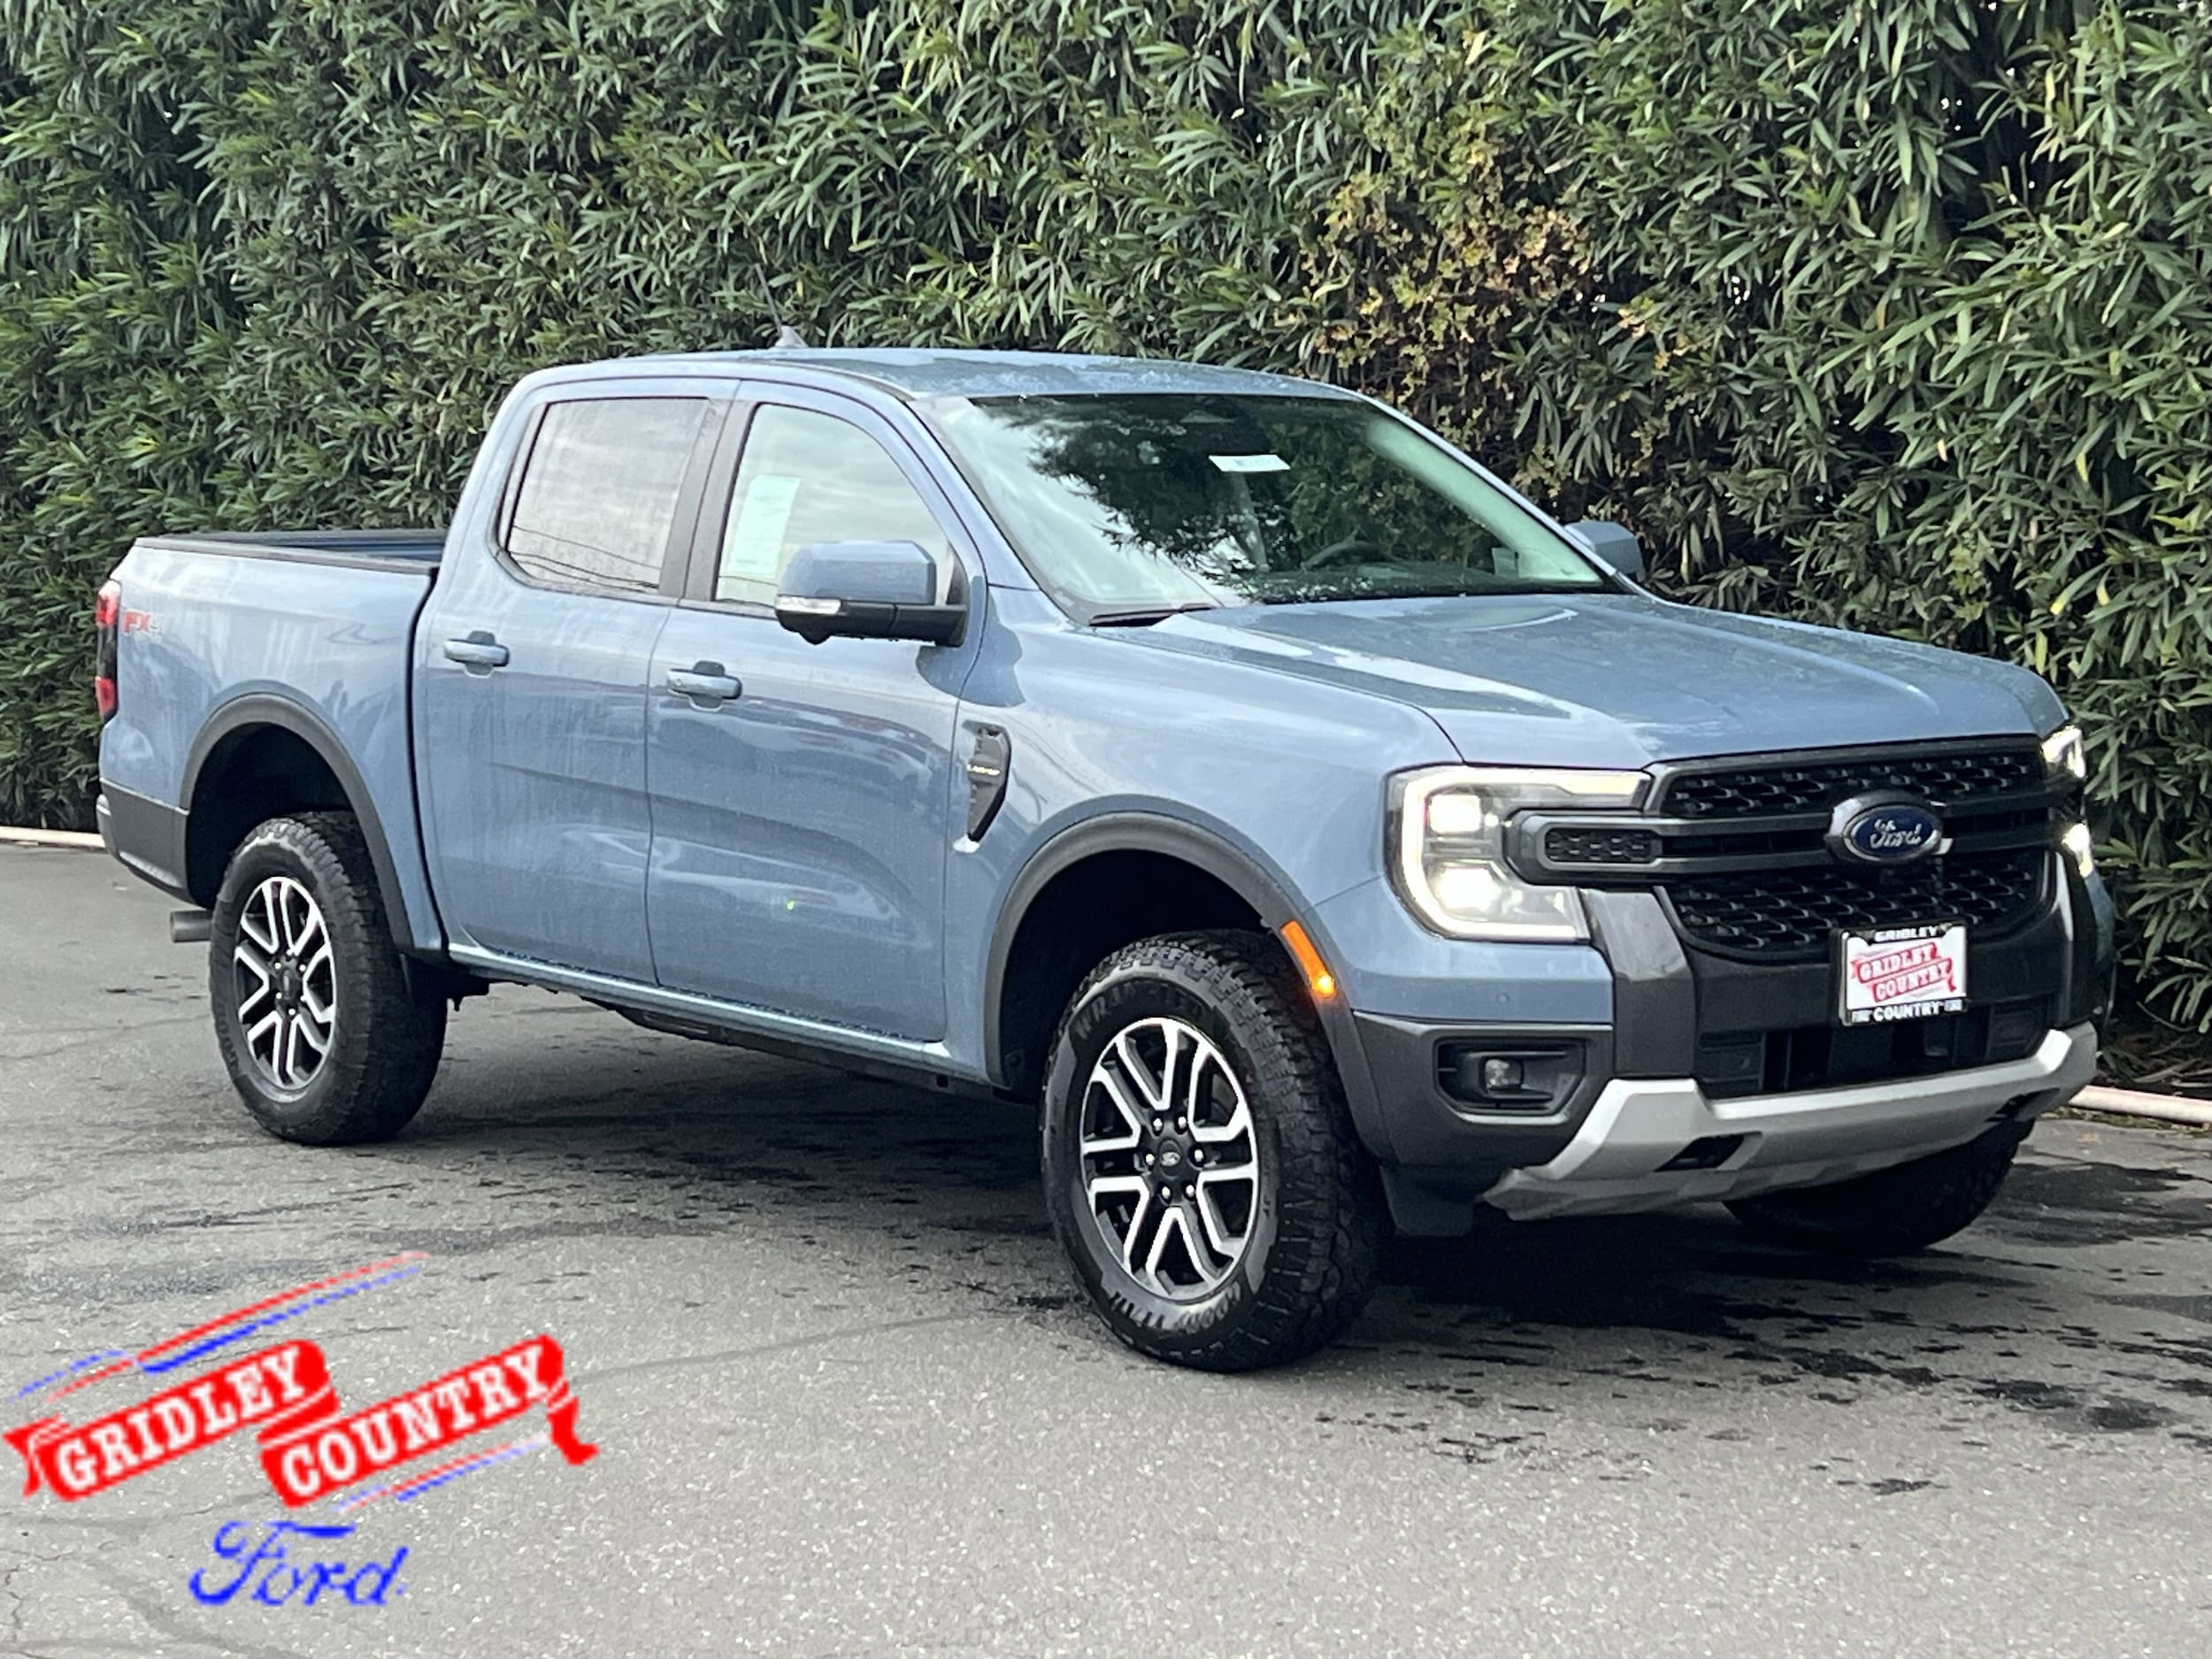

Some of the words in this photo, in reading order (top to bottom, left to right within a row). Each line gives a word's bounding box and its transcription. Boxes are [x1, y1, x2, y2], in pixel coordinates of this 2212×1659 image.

[1870, 818, 1923, 849] Ford
[1874, 927, 1939, 941] GRIDLEY
[1859, 945, 1933, 980] GRIDLEY
[1875, 962, 1950, 1002] COUNTRY
[1873, 1002, 1940, 1022] COUNTRY
